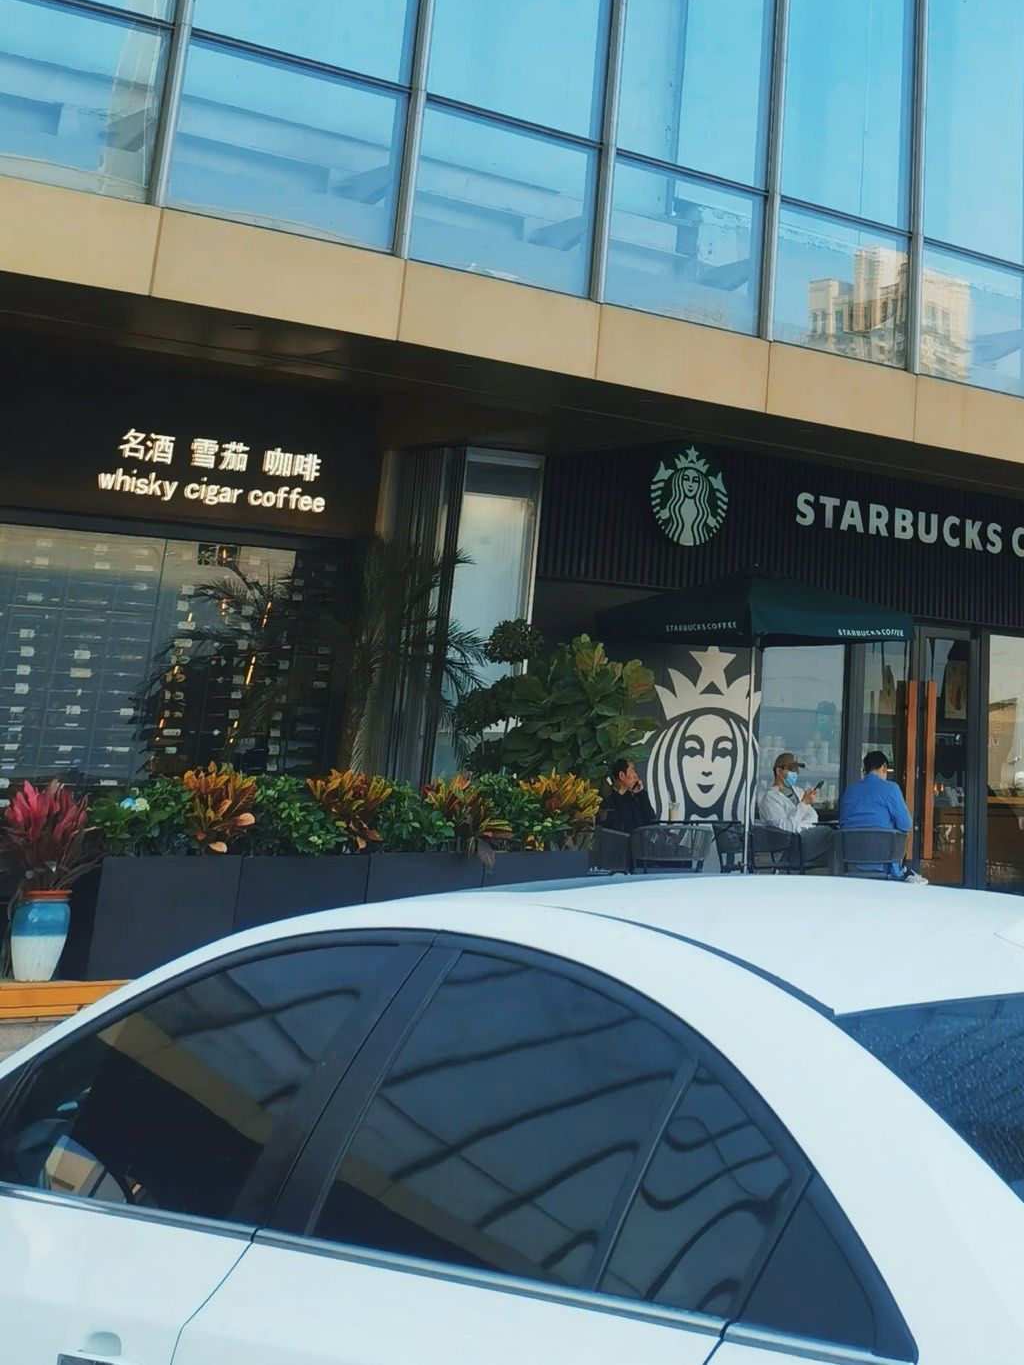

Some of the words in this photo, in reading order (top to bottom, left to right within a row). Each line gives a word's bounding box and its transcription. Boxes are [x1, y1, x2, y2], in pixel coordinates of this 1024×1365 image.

[118, 428, 176, 465] 名酒
[190, 438, 250, 472] 雪茄
[262, 447, 322, 482] 咖啡
[98, 468, 178, 501] whisky
[184, 477, 243, 505] cigar
[248, 486, 326, 513] coffee
[795, 491, 1003, 555] STARBUCKS
[665, 622, 706, 633] STARBUCKS
[706, 621, 737, 631] COFFEE
